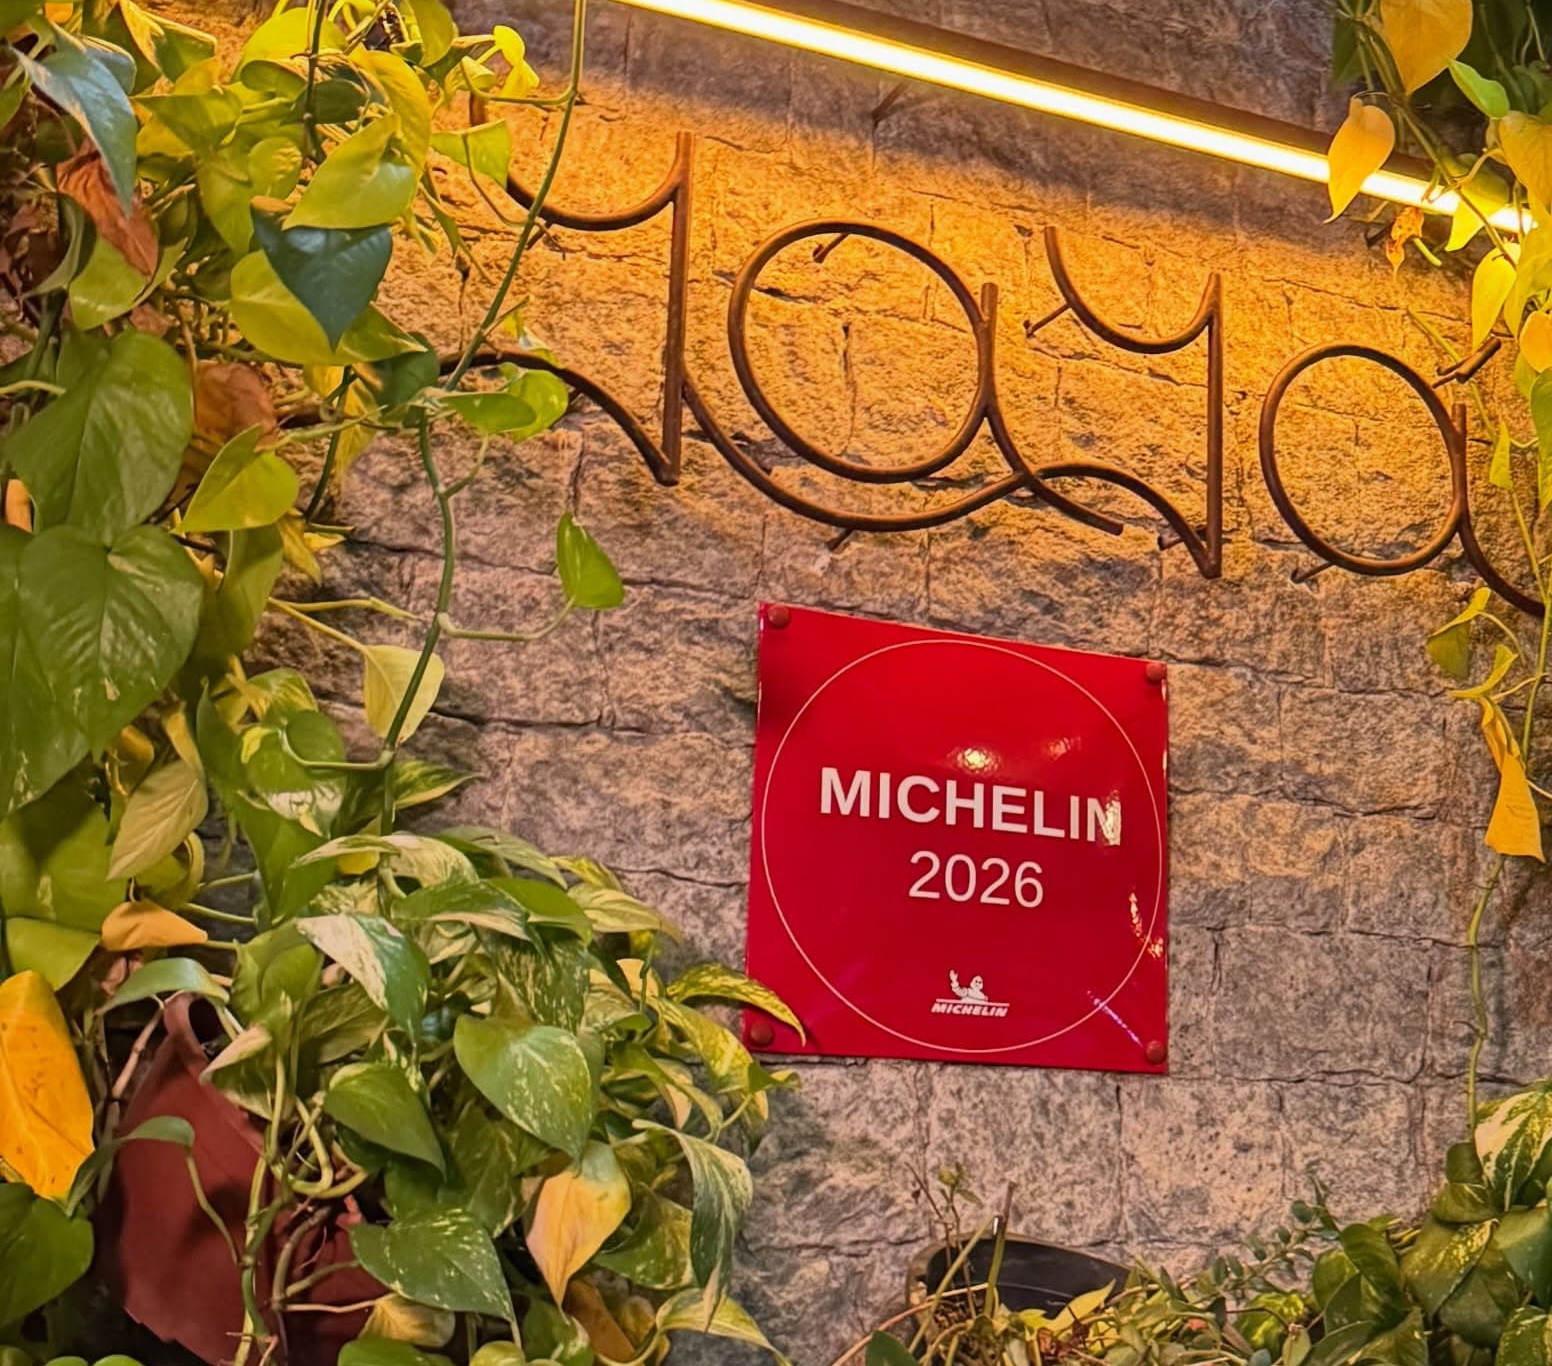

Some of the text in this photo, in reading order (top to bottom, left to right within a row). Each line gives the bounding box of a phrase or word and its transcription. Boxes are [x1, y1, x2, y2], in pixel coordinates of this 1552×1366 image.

[819, 766, 1122, 847] MICHELIN
[908, 850, 1045, 909] 2026
[931, 1002, 1009, 1018] MICHELIN
